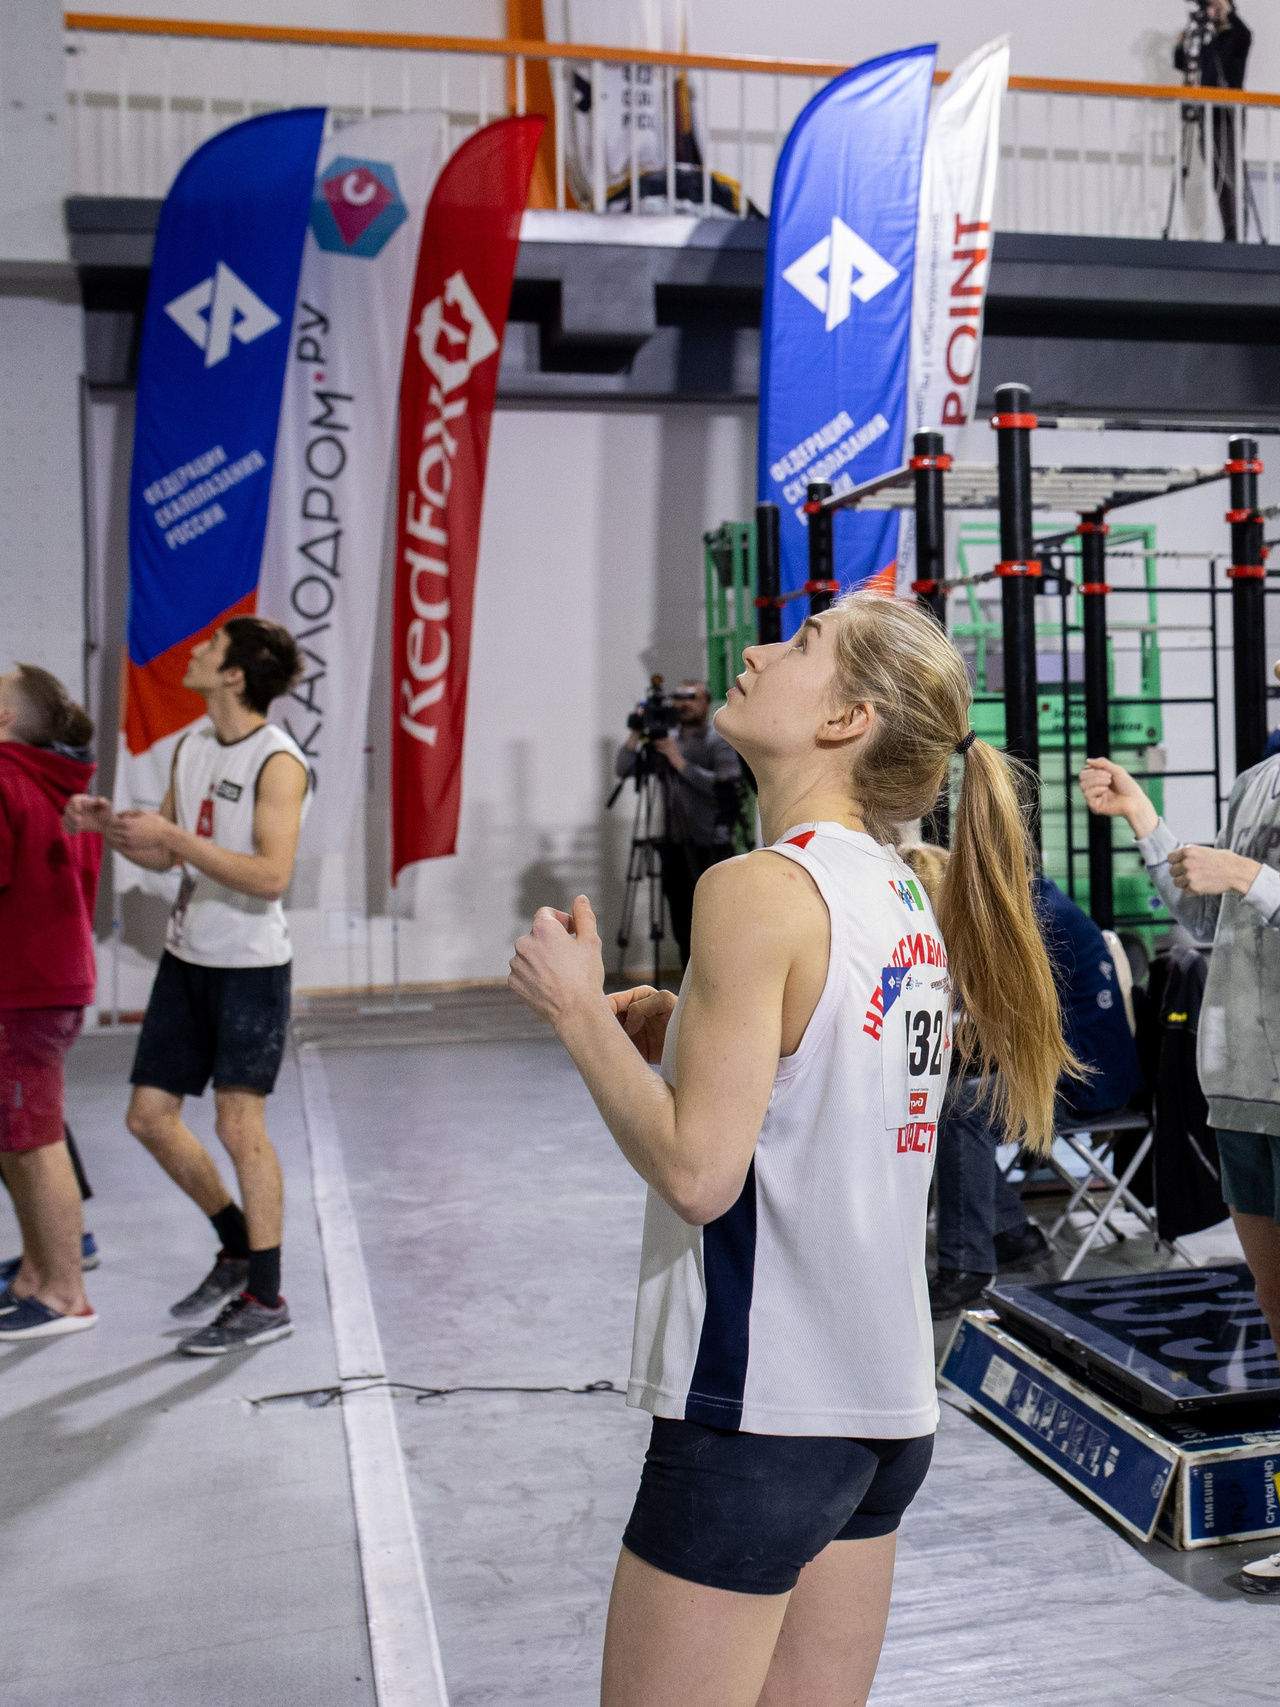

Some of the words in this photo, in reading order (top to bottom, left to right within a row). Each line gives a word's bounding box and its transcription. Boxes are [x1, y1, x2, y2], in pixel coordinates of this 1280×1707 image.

[941, 212, 990, 426] POINT
[1263, 1459, 1275, 1481] UHD
[1203, 1472, 1215, 1529] SAMSUNG
[1264, 1482, 1279, 1525] Crystal
